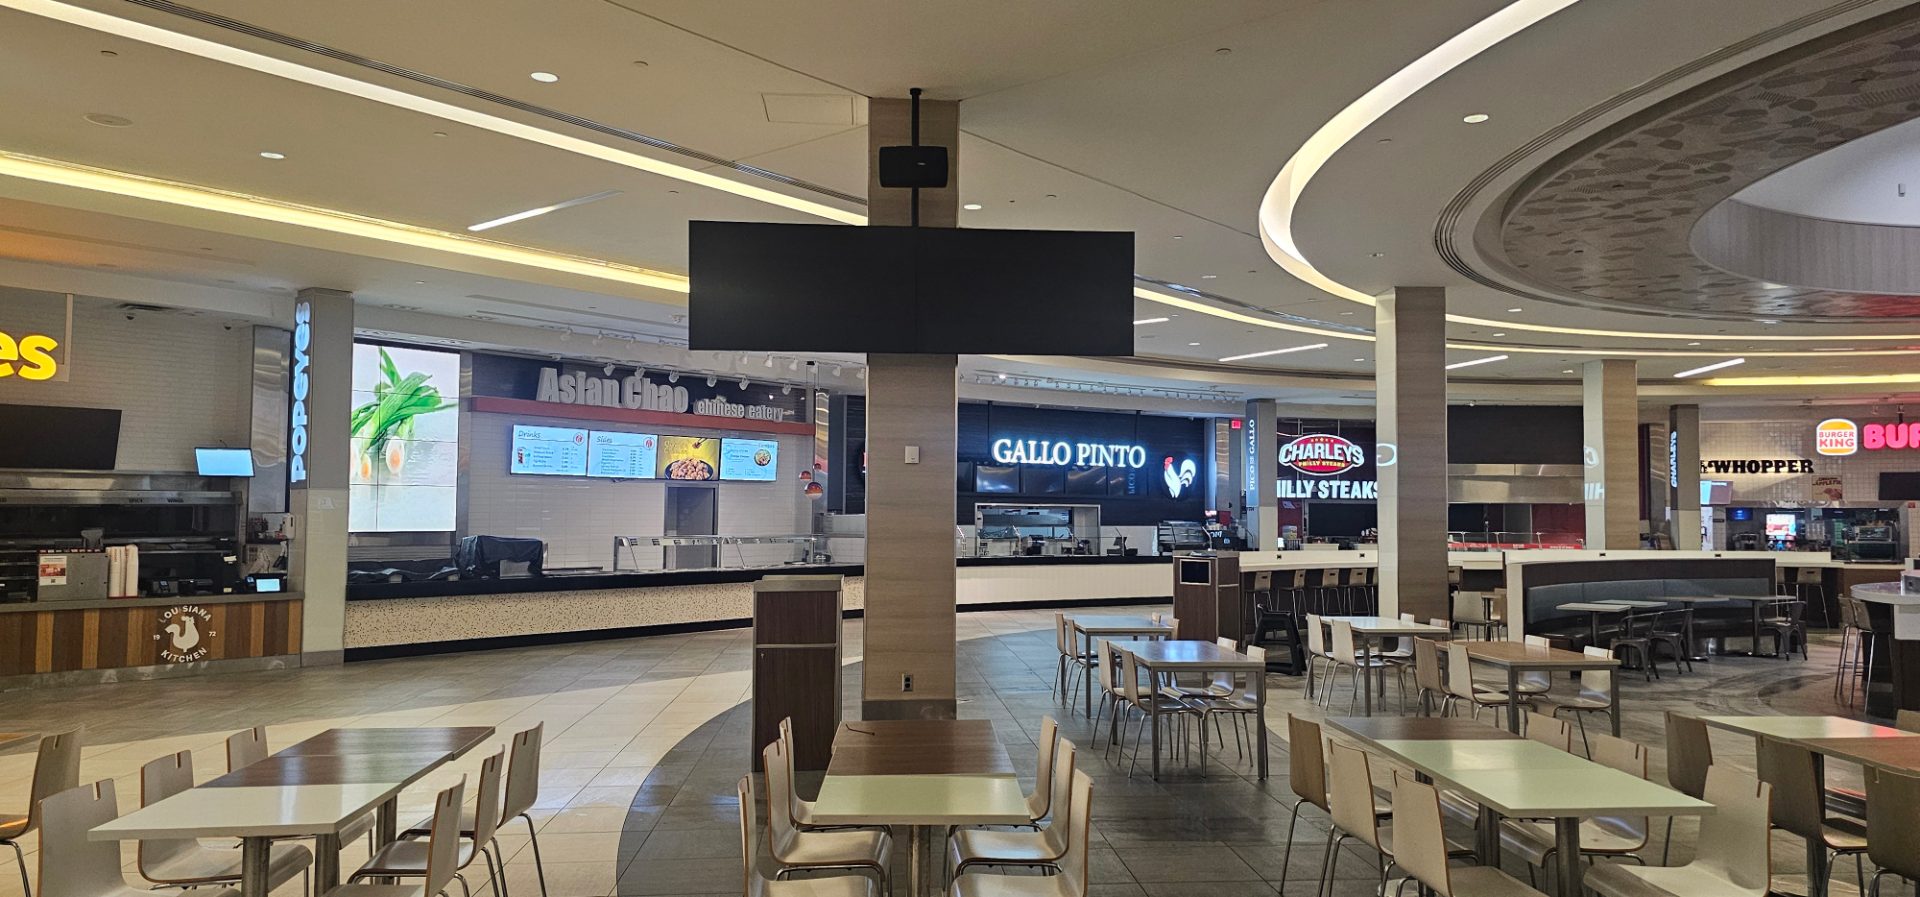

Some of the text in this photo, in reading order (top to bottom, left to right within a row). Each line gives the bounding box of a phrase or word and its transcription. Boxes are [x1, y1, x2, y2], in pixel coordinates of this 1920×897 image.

[535, 367, 689, 414] Asian Chao
[745, 404, 784, 423] eatery
[518, 430, 541, 438] Drinks
[1248, 419, 1256, 455] GALLO
[1818, 438, 1855, 448] KING
[992, 438, 1147, 469] GALLO PINTO
[1278, 443, 1365, 467] CHARLEYS
[1708, 459, 1815, 474] WHOPPER
[161, 647, 208, 663] KITCHEN
